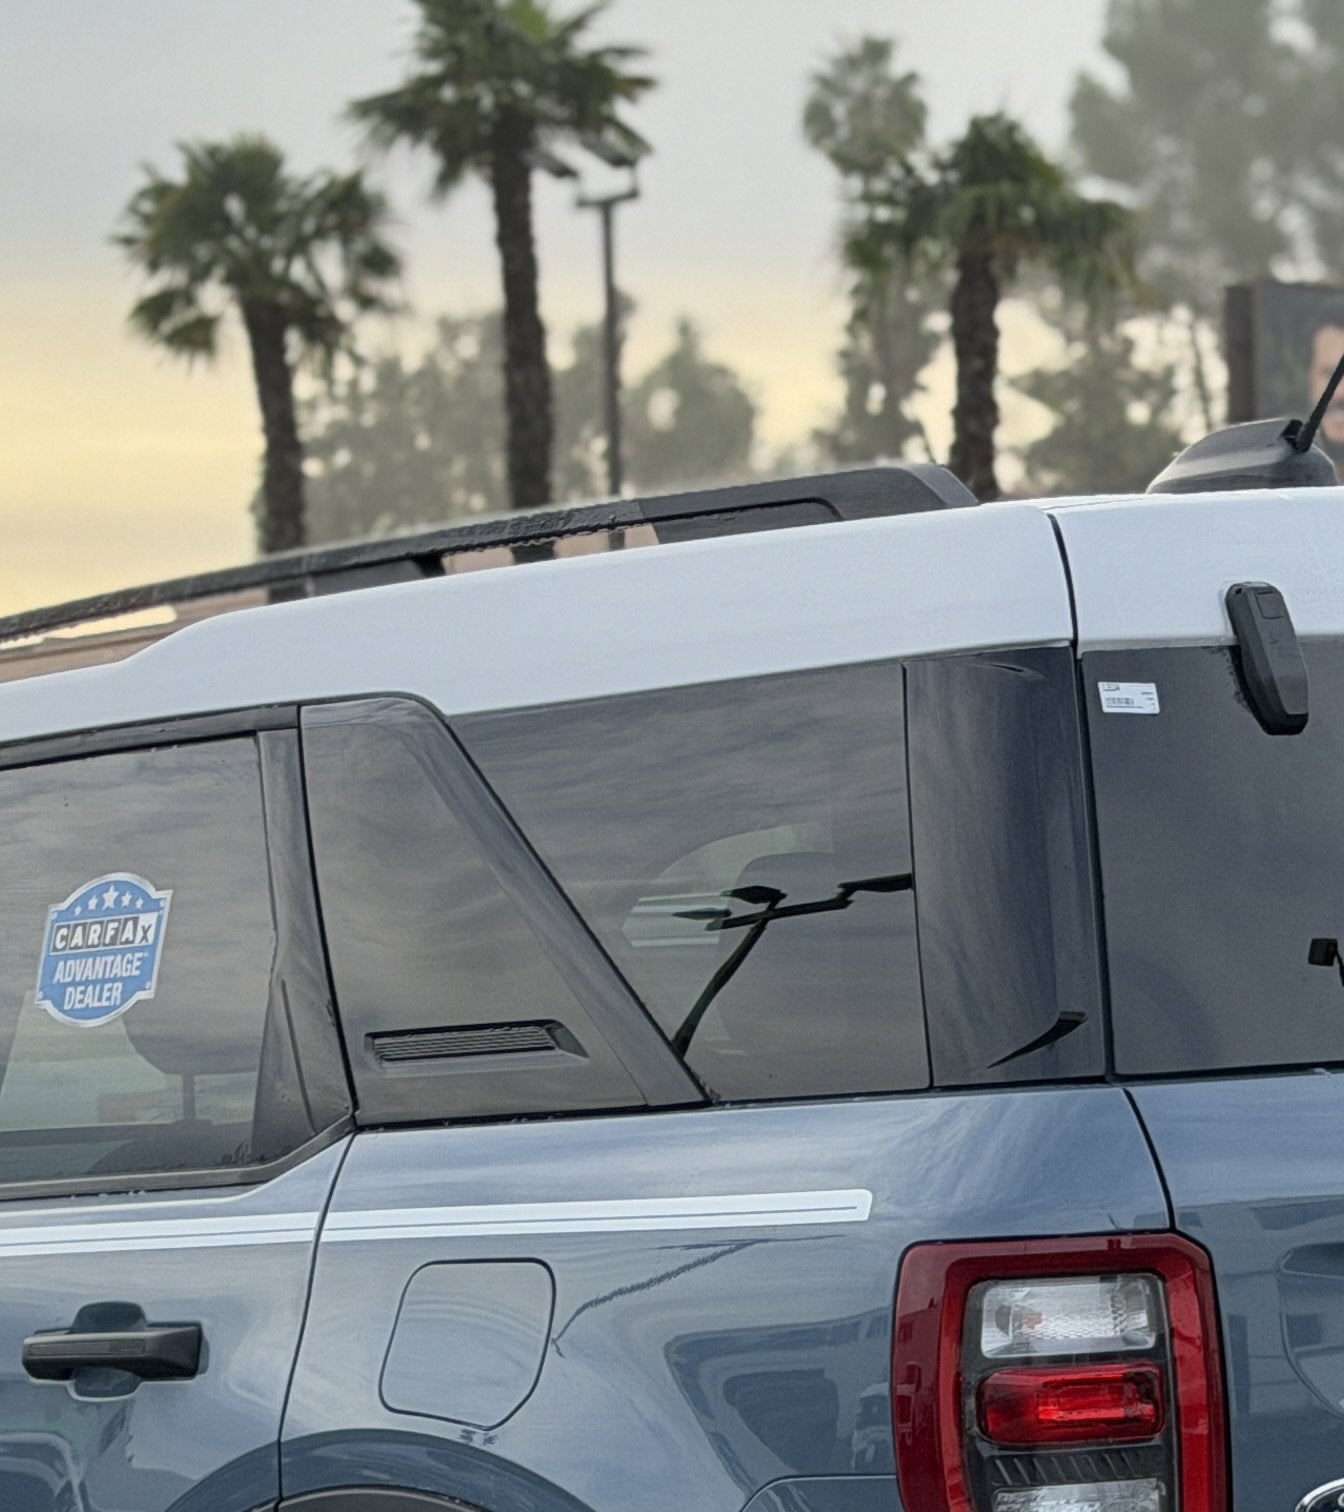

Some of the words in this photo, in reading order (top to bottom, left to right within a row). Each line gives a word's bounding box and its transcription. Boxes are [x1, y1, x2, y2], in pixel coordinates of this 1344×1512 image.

[55, 917, 152, 950] CARFAX
[53, 951, 143, 984] ADVANTAGE
[63, 982, 123, 1010] DEALER
